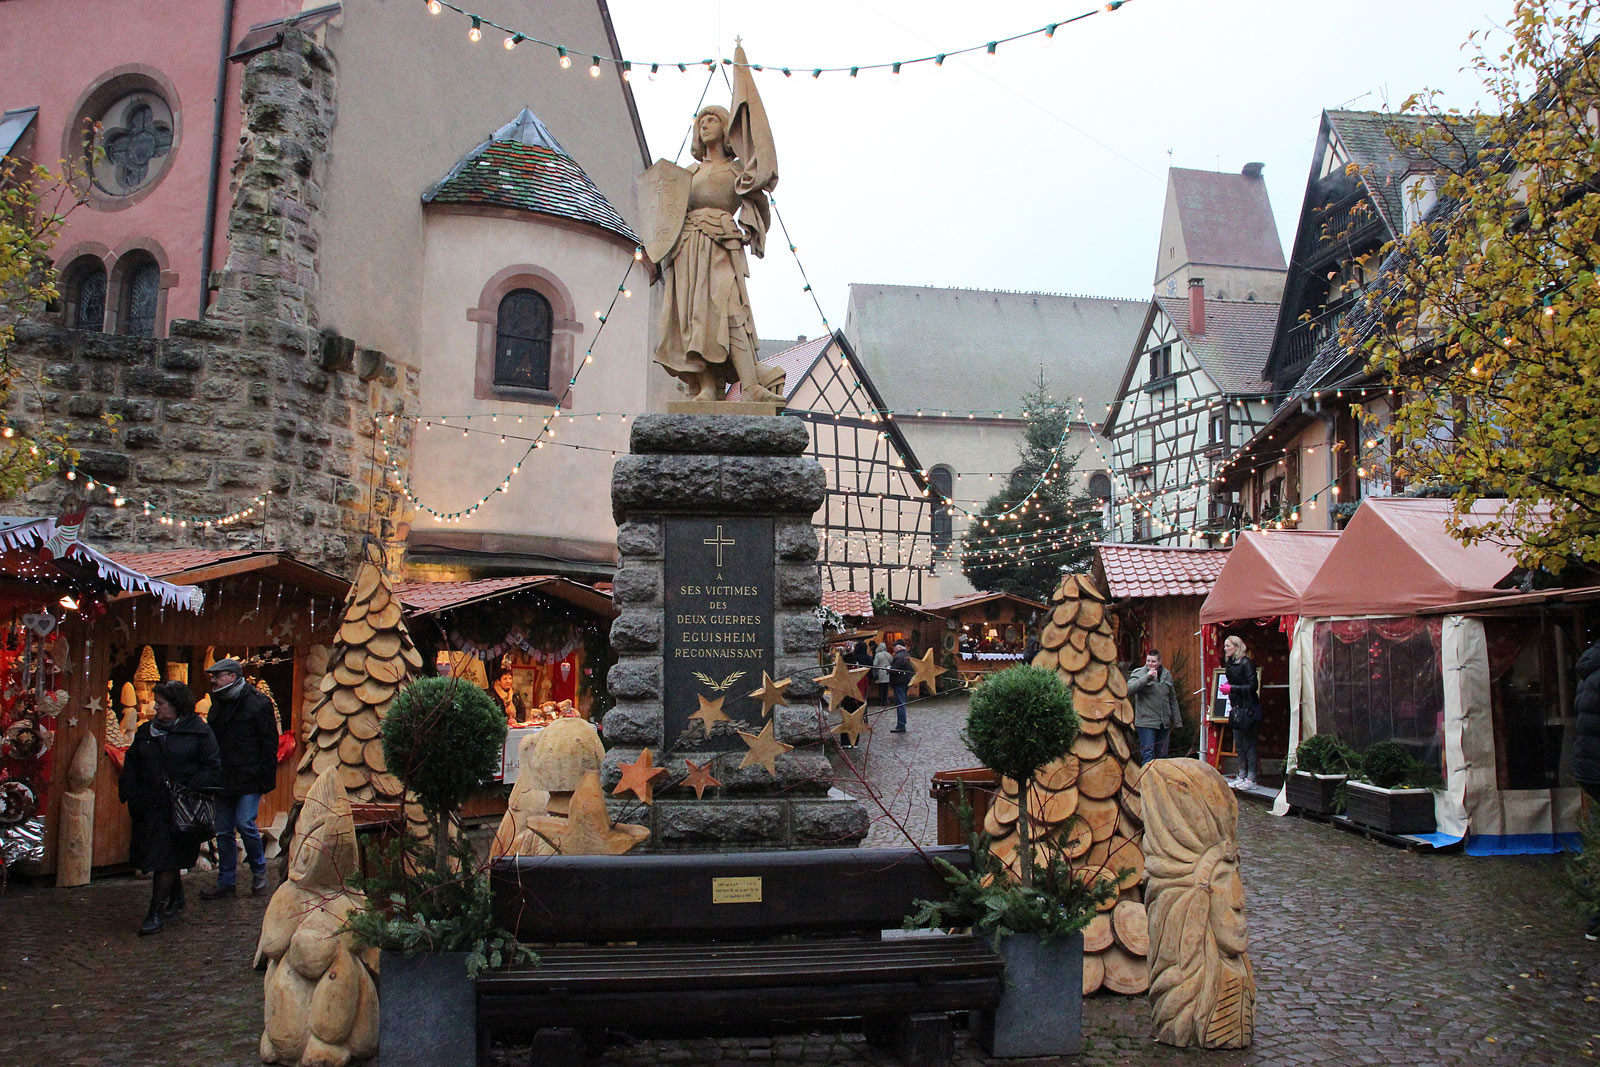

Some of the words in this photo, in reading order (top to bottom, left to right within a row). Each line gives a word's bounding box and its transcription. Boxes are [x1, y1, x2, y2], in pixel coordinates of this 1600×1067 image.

[680, 585, 701, 595] SES
[705, 585, 758, 596] VICTIMES
[709, 601, 727, 610] DES
[677, 614, 707, 625] DEUX
[711, 615, 761, 625] GUERRES
[682, 632, 756, 643] EGUISHEIM
[674, 648, 764, 659] RECONNAISSANT
